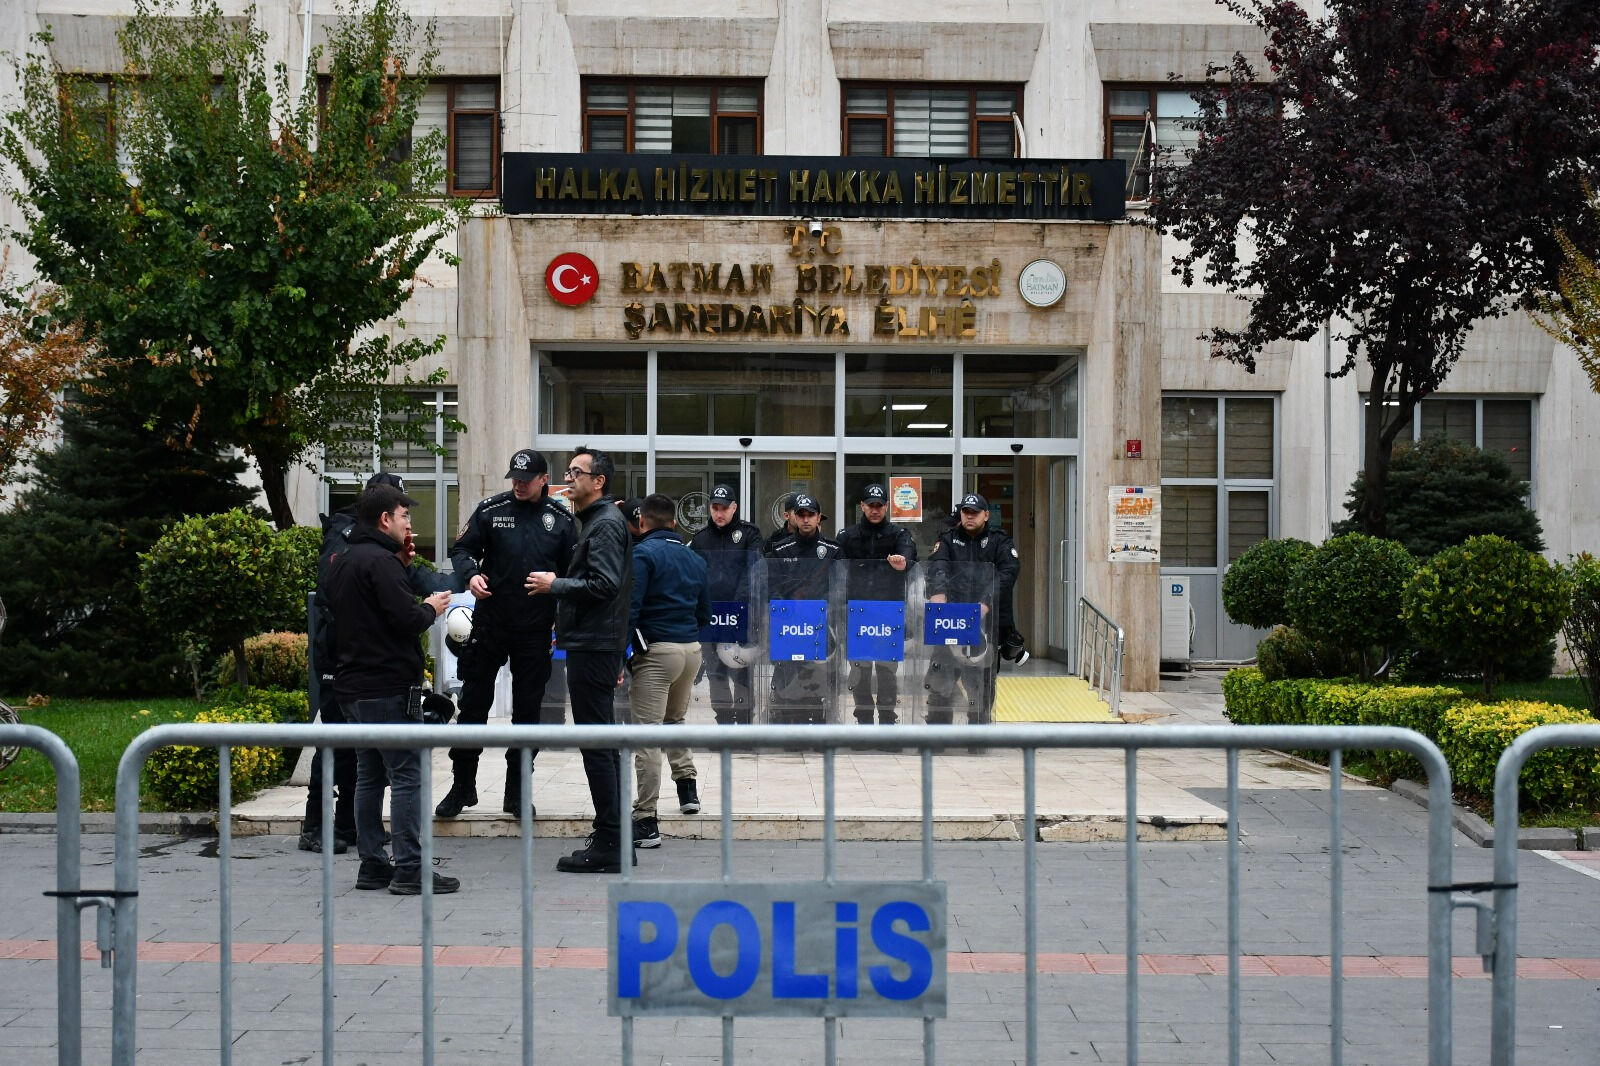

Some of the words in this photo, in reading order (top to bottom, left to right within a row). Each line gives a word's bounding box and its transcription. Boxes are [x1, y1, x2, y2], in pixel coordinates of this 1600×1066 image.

[534, 167, 643, 201] HALKA
[655, 160, 779, 203] HİZMET
[789, 169, 903, 204] HAKKA
[914, 164, 1092, 206] HİZMETTİR
[621, 262, 773, 294] BATMAN
[796, 257, 1001, 297] BELEDİYESİ
[1026, 283, 1059, 291] BATMAN
[782, 622, 814, 636] POLİS
[860, 623, 892, 637] POLİS
